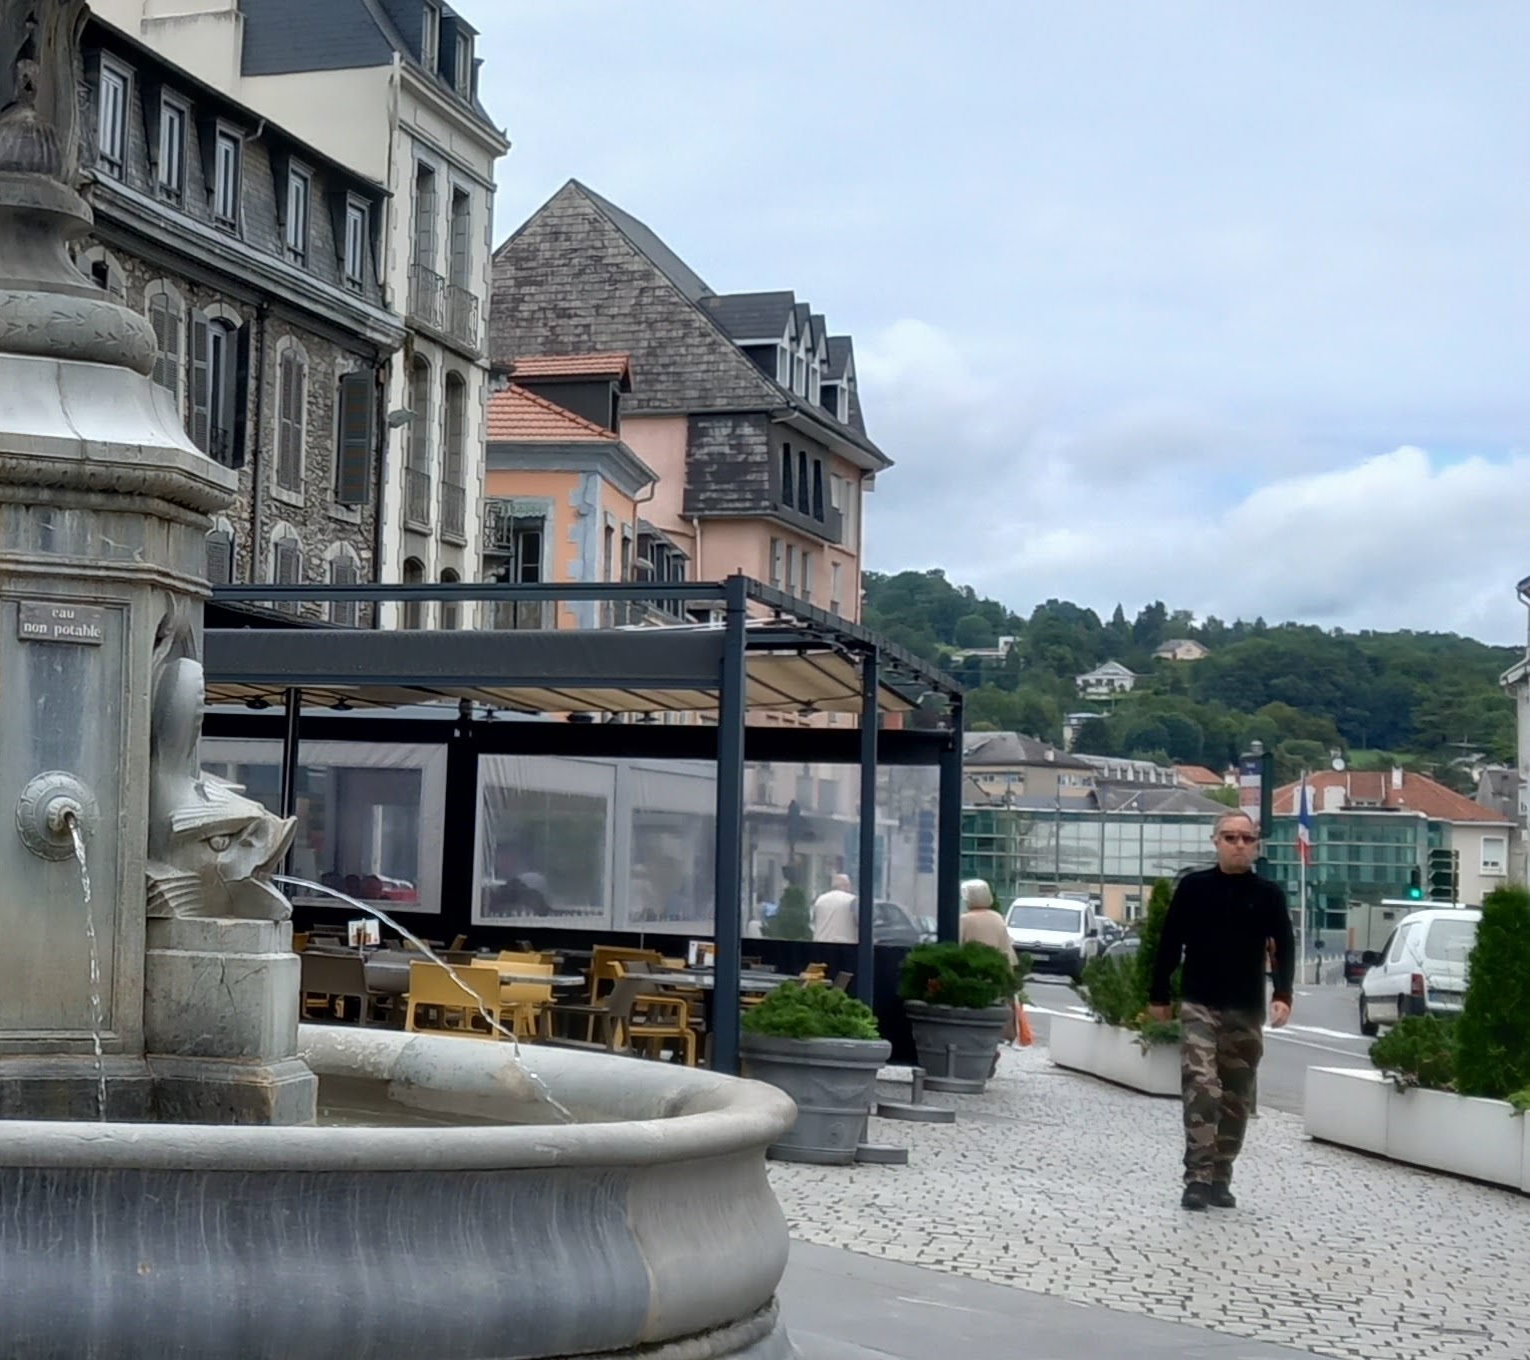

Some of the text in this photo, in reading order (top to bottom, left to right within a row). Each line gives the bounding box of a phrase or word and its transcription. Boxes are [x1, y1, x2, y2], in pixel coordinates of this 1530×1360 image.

[51, 608, 75, 619] eau
[23, 622, 102, 638] non potable
